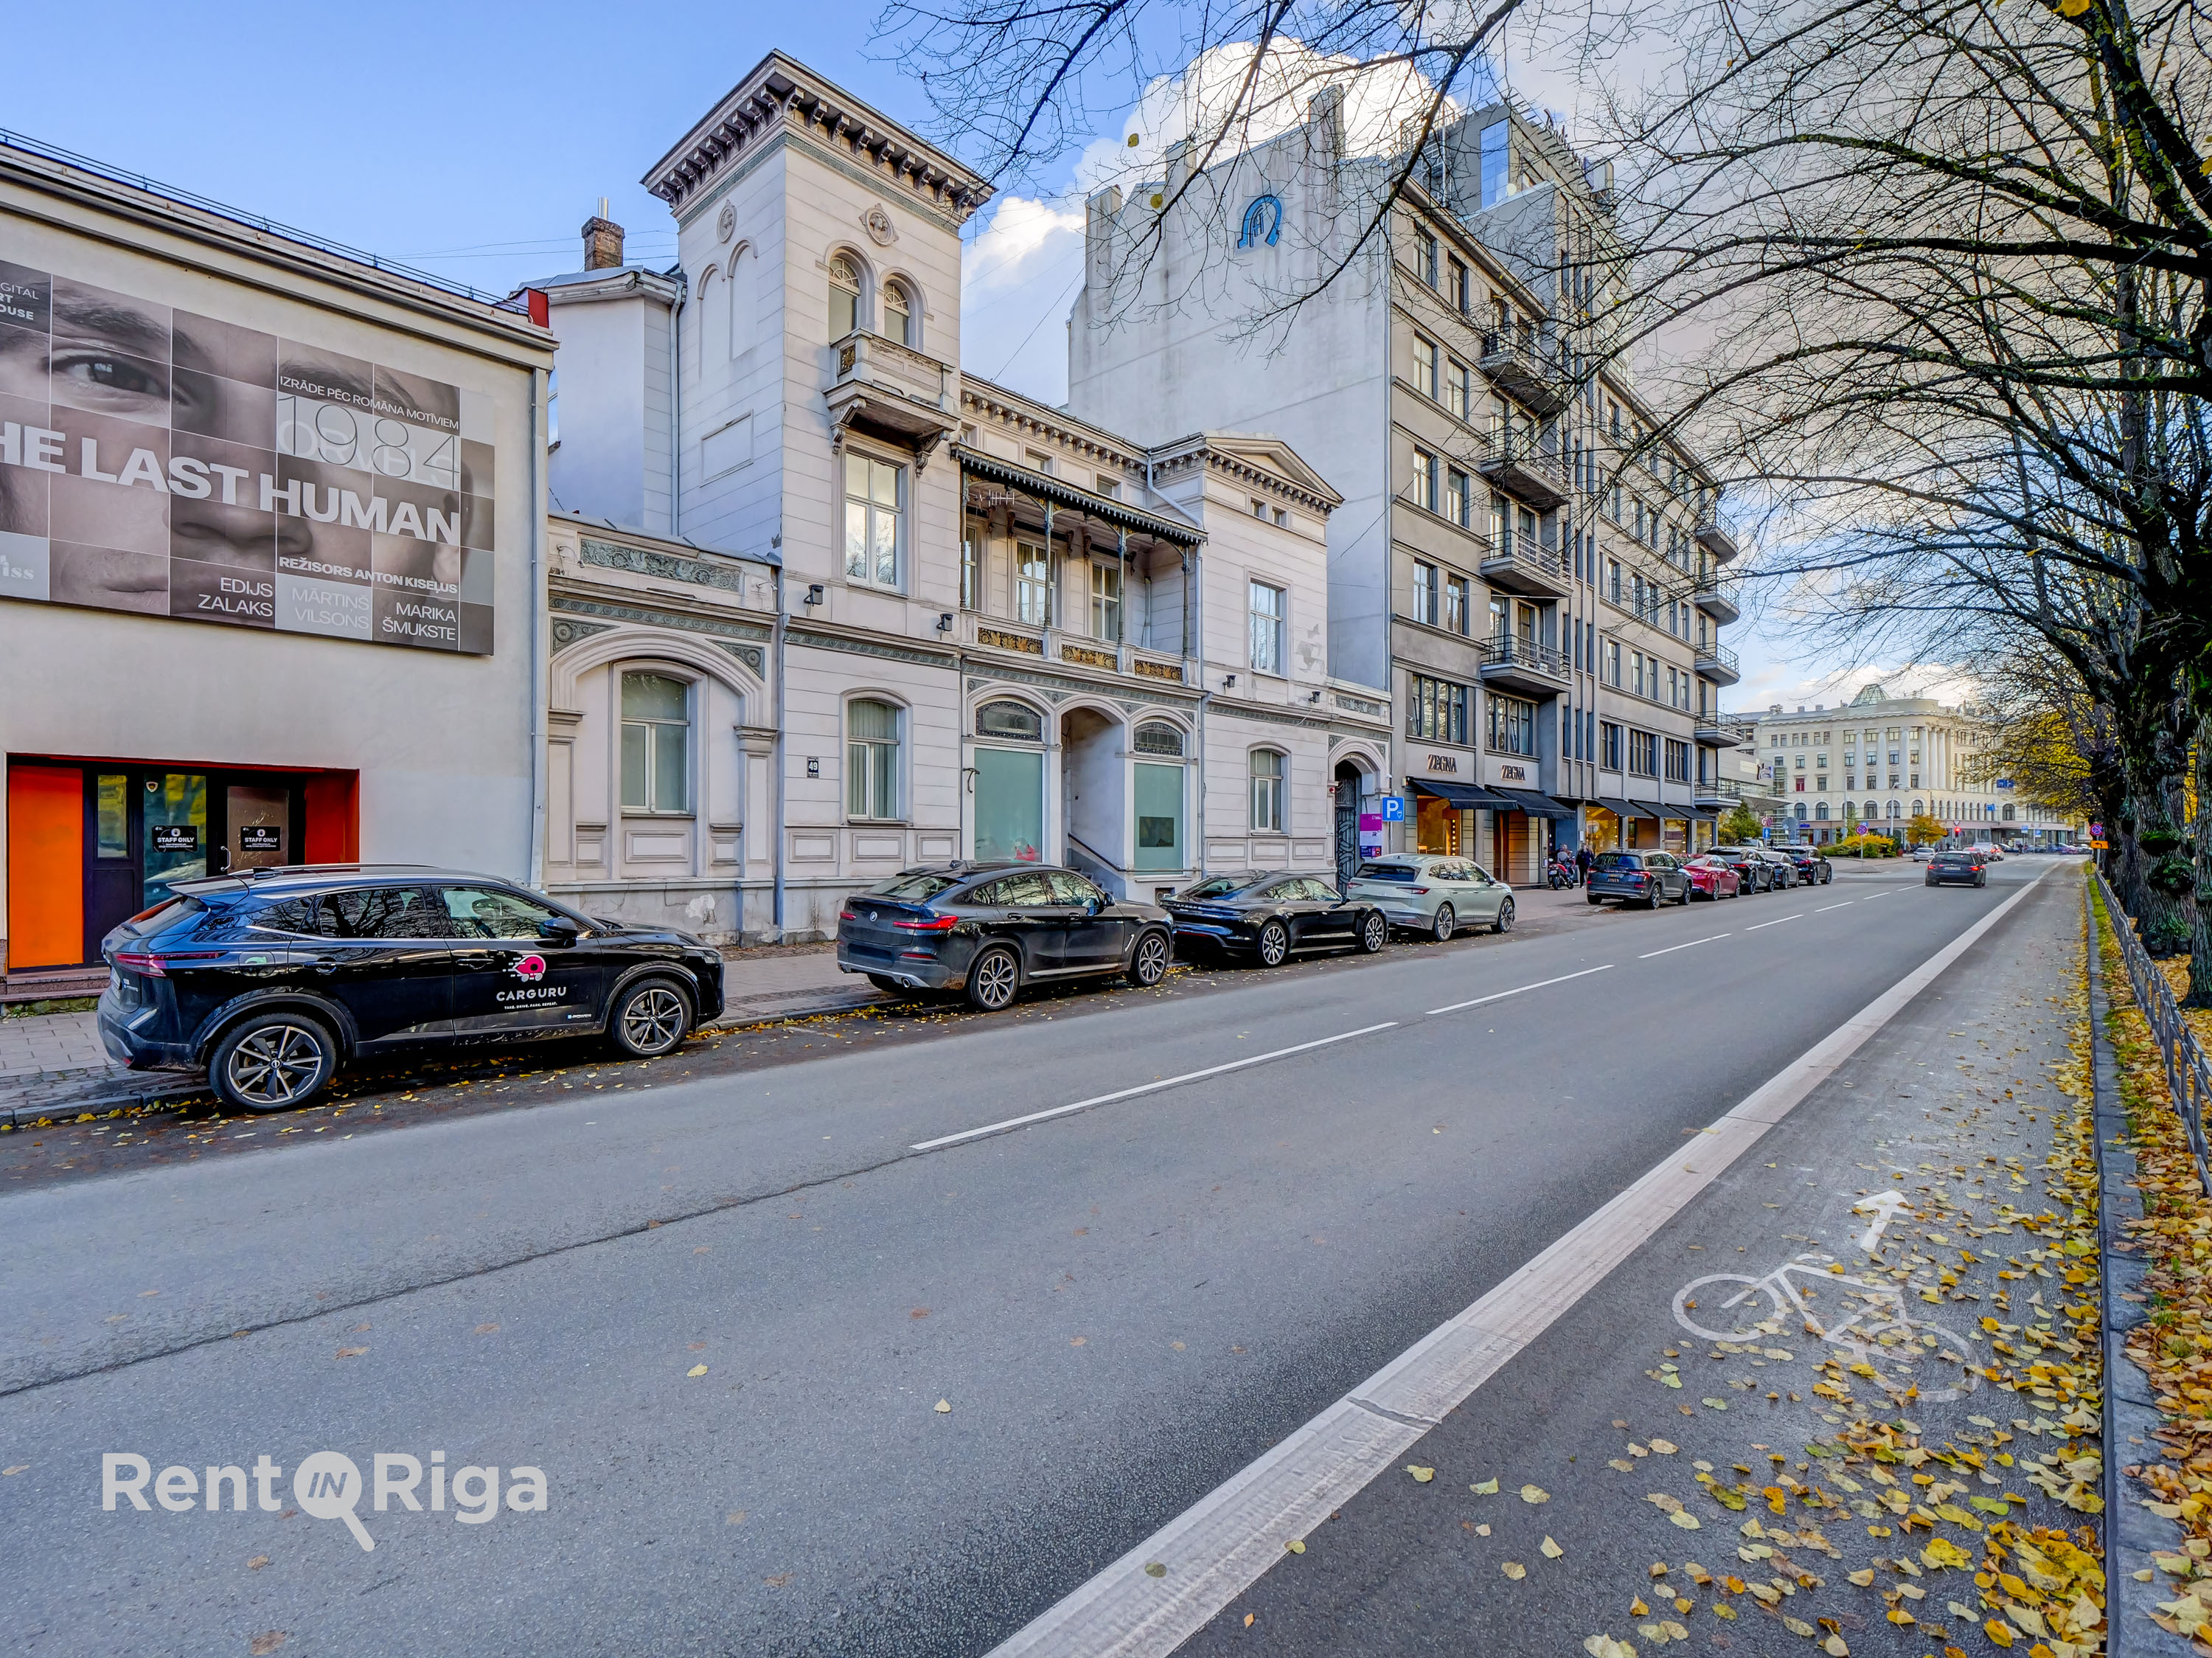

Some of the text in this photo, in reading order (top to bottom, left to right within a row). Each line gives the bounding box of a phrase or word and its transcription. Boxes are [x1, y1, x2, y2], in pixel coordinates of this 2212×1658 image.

[280, 375, 459, 429] IZRĀDE PĒC ROMĀNA MOTĪVIEM
[277, 395, 460, 490] 1984
[81, 437, 249, 505] LAST
[260, 473, 460, 545] HUMAN
[279, 556, 458, 594] REŽISORS ANTON KISEĻUS
[221, 577, 274, 597] EDIJS
[198, 594, 274, 617] ZALAKS
[395, 602, 456, 623] MARIKA
[295, 607, 369, 629] VILSONS
[382, 617, 456, 642] ŠMUKSTE
[809, 761, 818, 771] 49
[1427, 754, 1457, 773] ZEGNA
[1501, 765, 1525, 780] ZEGNA
[1387, 799, 1399, 818] P
[495, 986, 567, 1002] CARGURU
